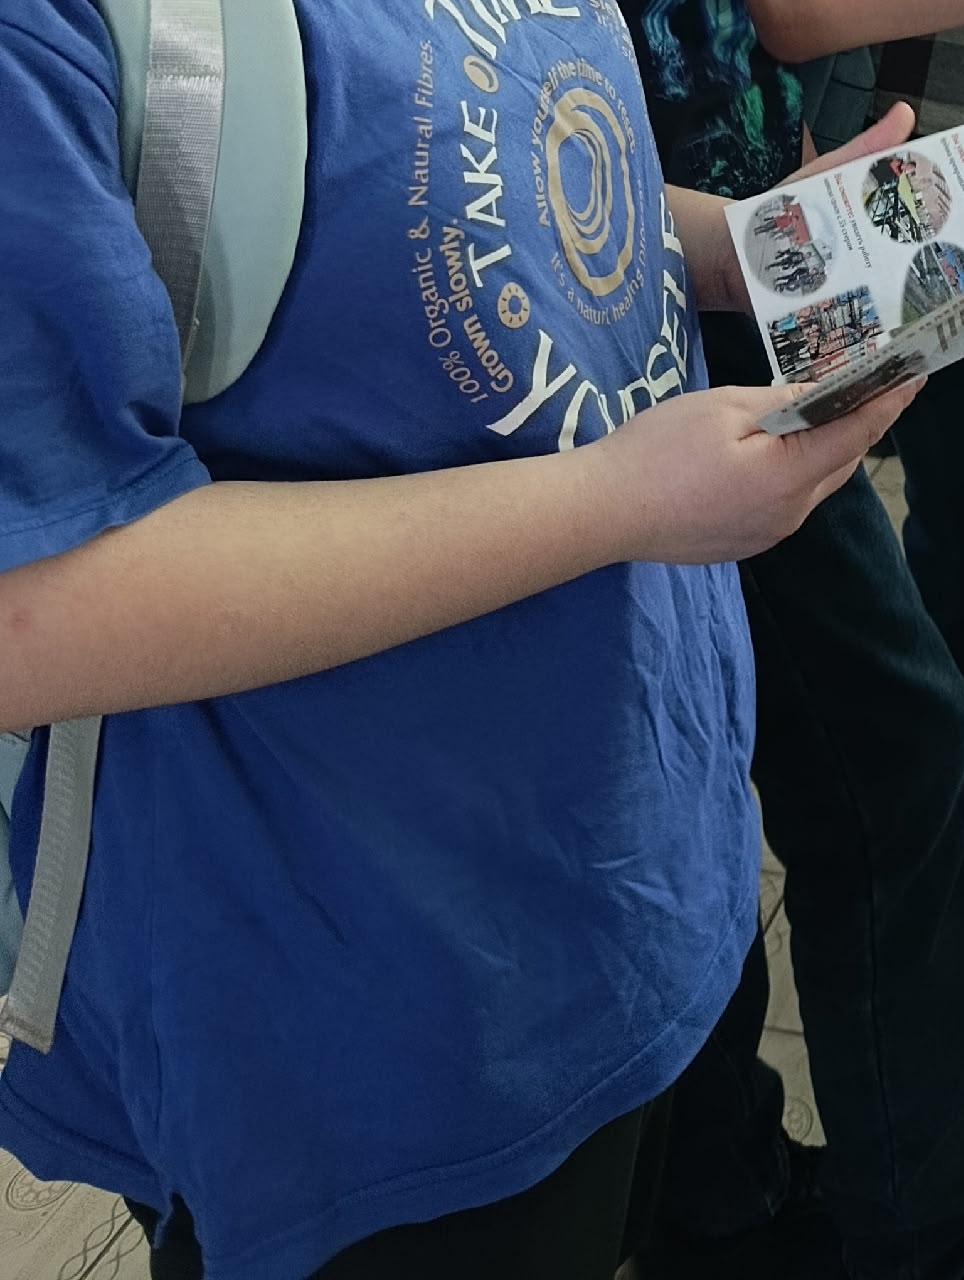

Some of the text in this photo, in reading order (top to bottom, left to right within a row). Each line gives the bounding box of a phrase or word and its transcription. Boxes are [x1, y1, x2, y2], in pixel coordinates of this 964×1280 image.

[413, 39, 433, 108] Fibres.
[531, 151, 550, 227] Allow
[556, 60, 576, 80] the
[604, 77, 616, 100] to
[407, 216, 431, 239] &
[460, 100, 512, 289] TAKE
[411, 247, 453, 348] Organic
[439, 217, 515, 394] Grown slowly.
[439, 351, 489, 404] 100%
